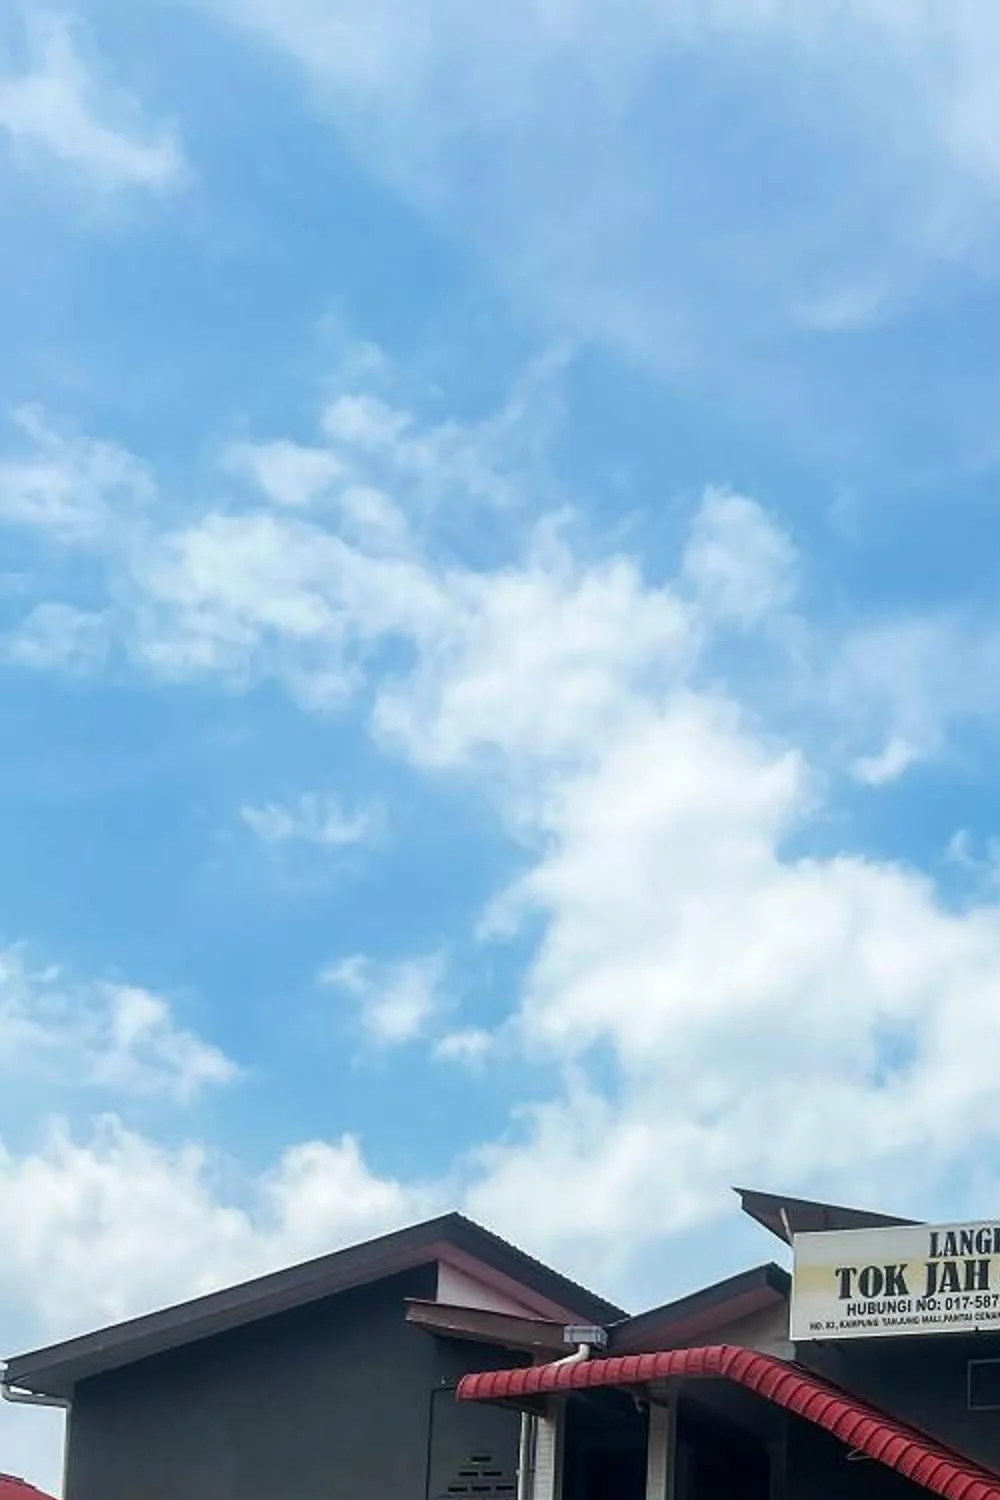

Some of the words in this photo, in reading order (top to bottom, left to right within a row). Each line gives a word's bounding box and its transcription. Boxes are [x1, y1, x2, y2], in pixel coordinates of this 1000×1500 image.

[835, 1263, 910, 1299] TOK
[922, 1259, 990, 1299] JAH
[847, 1300, 911, 1317] HUBUNGI
[916, 1298, 941, 1313] NO:
[840, 1315, 879, 1329] KAMPUNG
